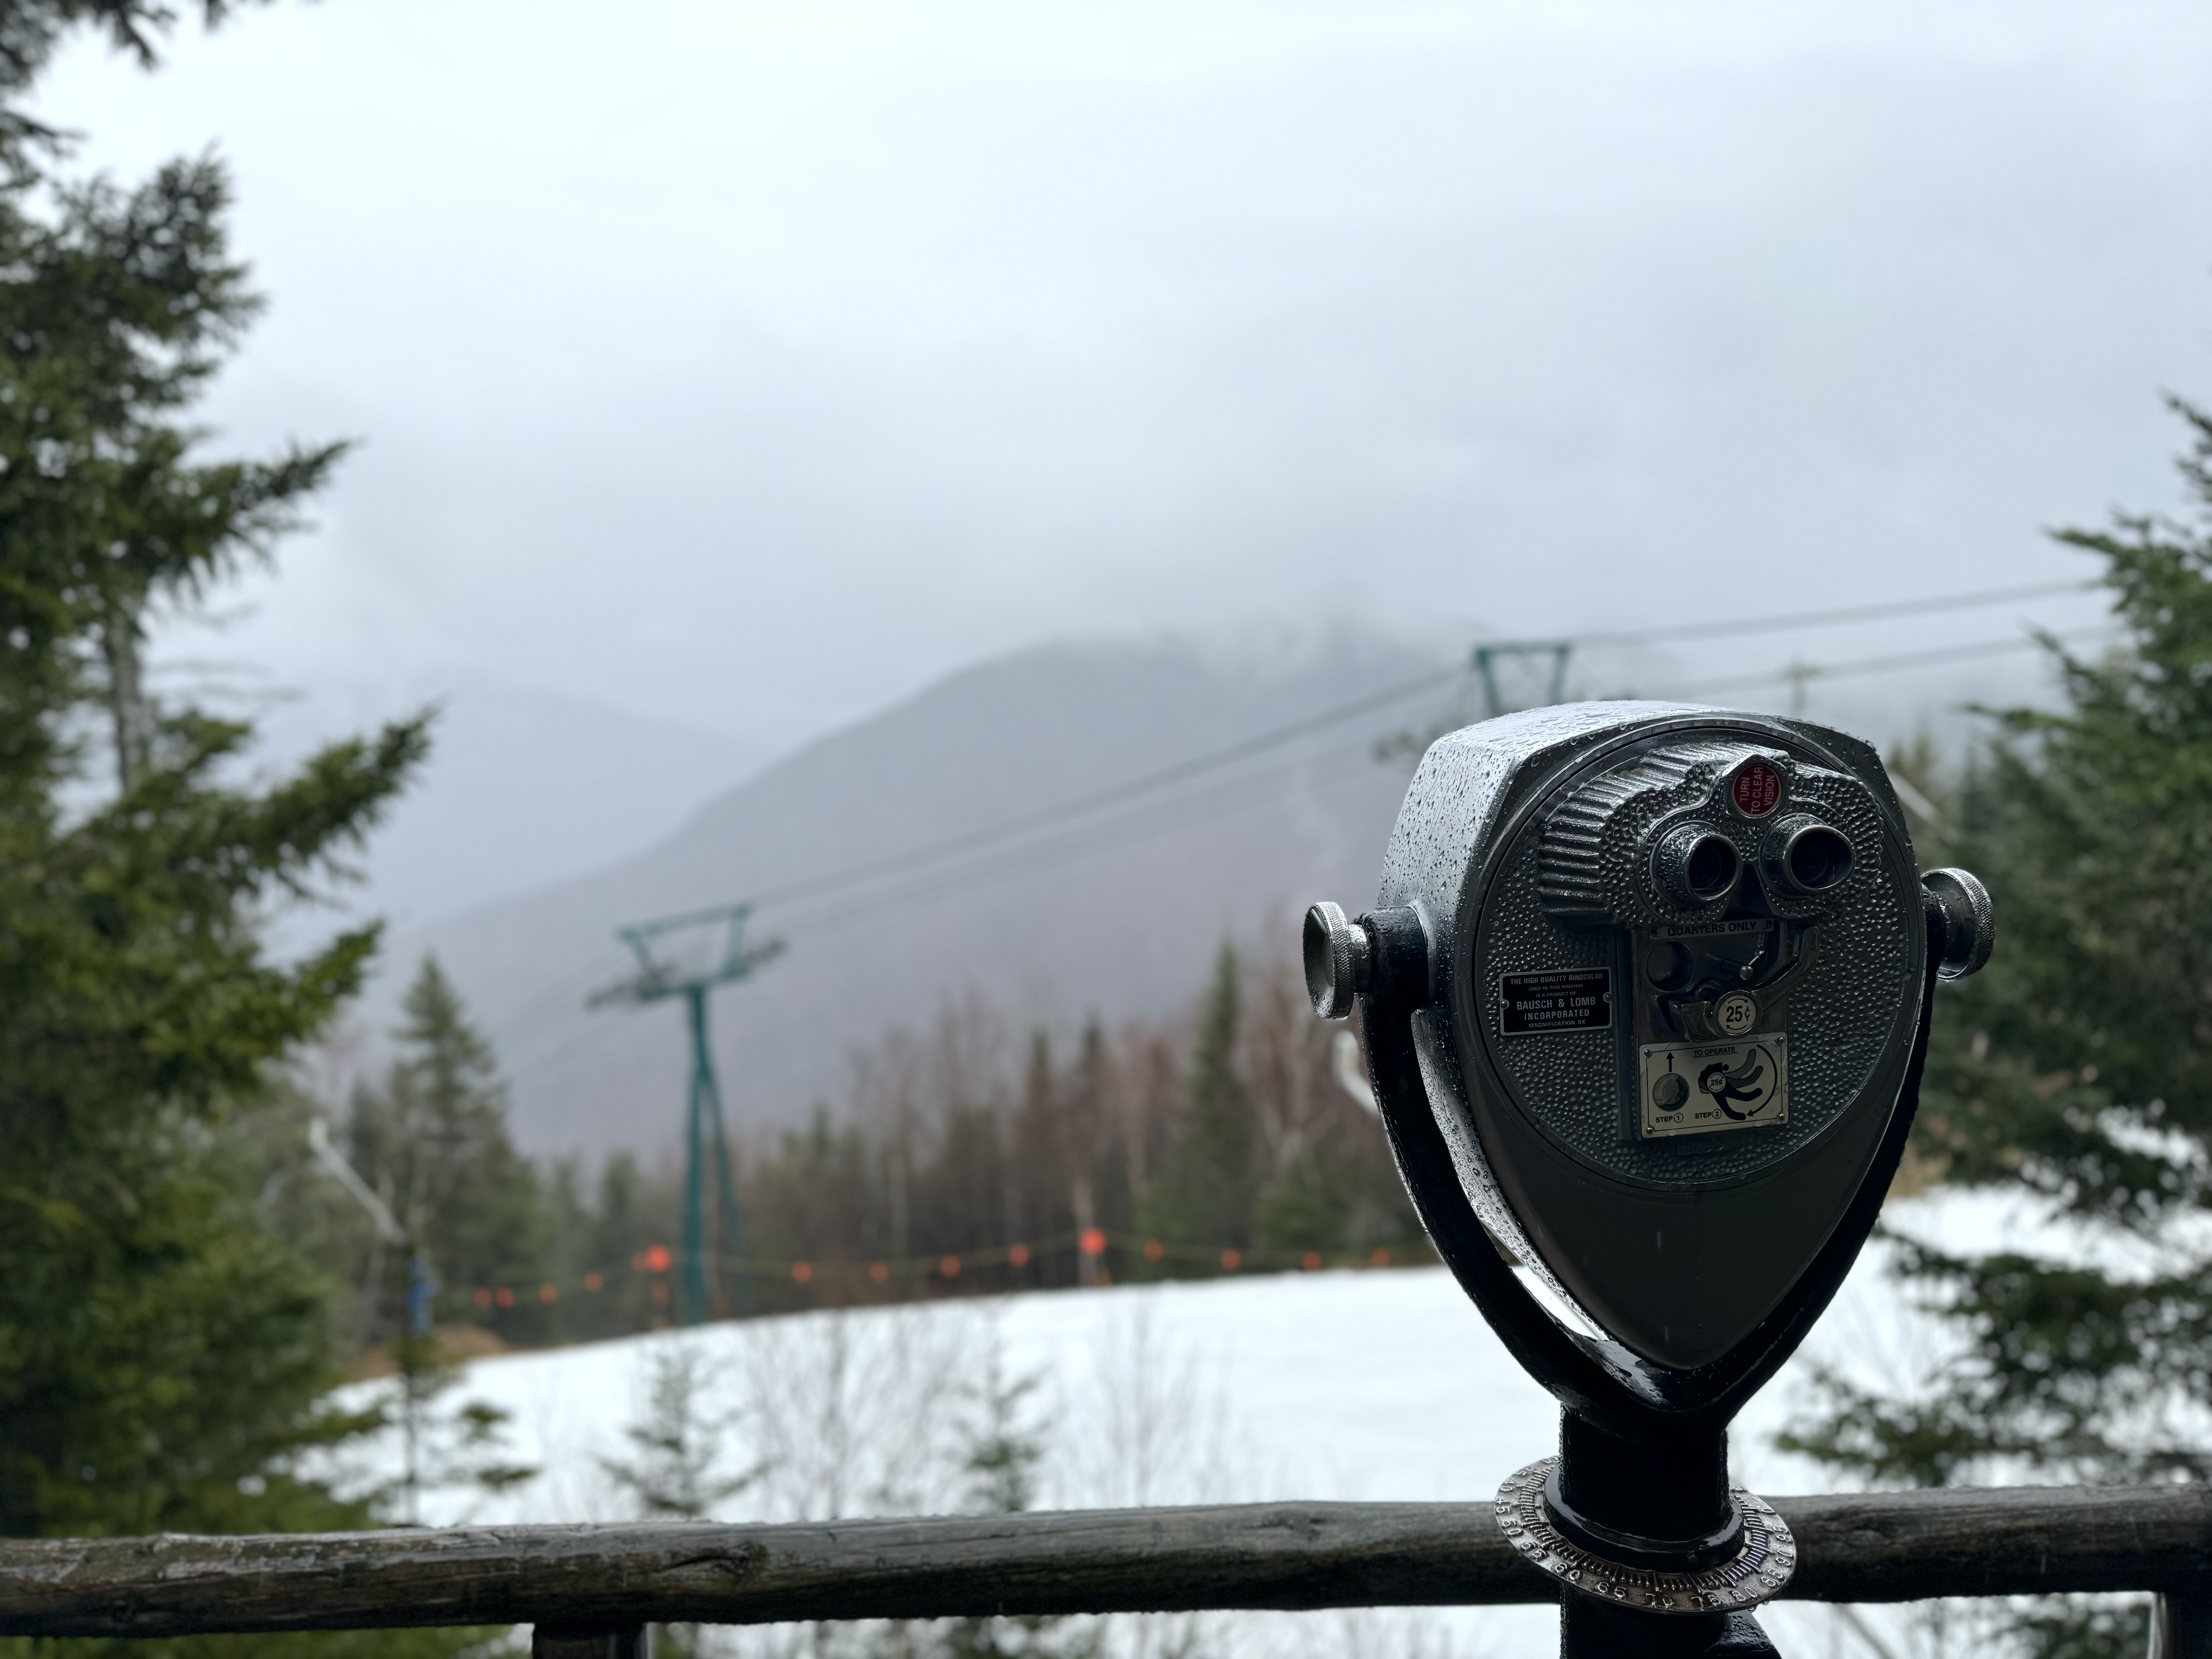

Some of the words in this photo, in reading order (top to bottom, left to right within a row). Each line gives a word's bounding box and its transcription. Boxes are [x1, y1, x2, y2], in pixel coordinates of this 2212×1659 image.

[1740, 777, 1750, 802] TURN
[1752, 767, 1763, 798] CLEAR
[1764, 775, 1775, 805] VISION
[1751, 801, 1760, 813] TO
[1668, 923, 1725, 936] QUARTERS
[1728, 921, 1756, 931] ONLY
[1517, 1000, 1553, 1010] BAUSCH
[1558, 999, 1565, 1007] &
[1571, 997, 1596, 1006] LOMB
[1525, 1009, 1589, 1020] INCORPORATED
[1726, 1005, 1750, 1023] 25¢
[1705, 1047, 1736, 1055] OPERATE
[1500, 1479, 1516, 1492] 40
[1496, 1498, 1512, 1514] 45
[1772, 1526, 1792, 1542] 95
[1776, 1549, 1793, 1567] 90
[1555, 1562, 1580, 1580] 60
[1761, 1568, 1784, 1586] 85
[1646, 1593, 1674, 1608] 70
[1732, 1587, 1758, 1602] 80
